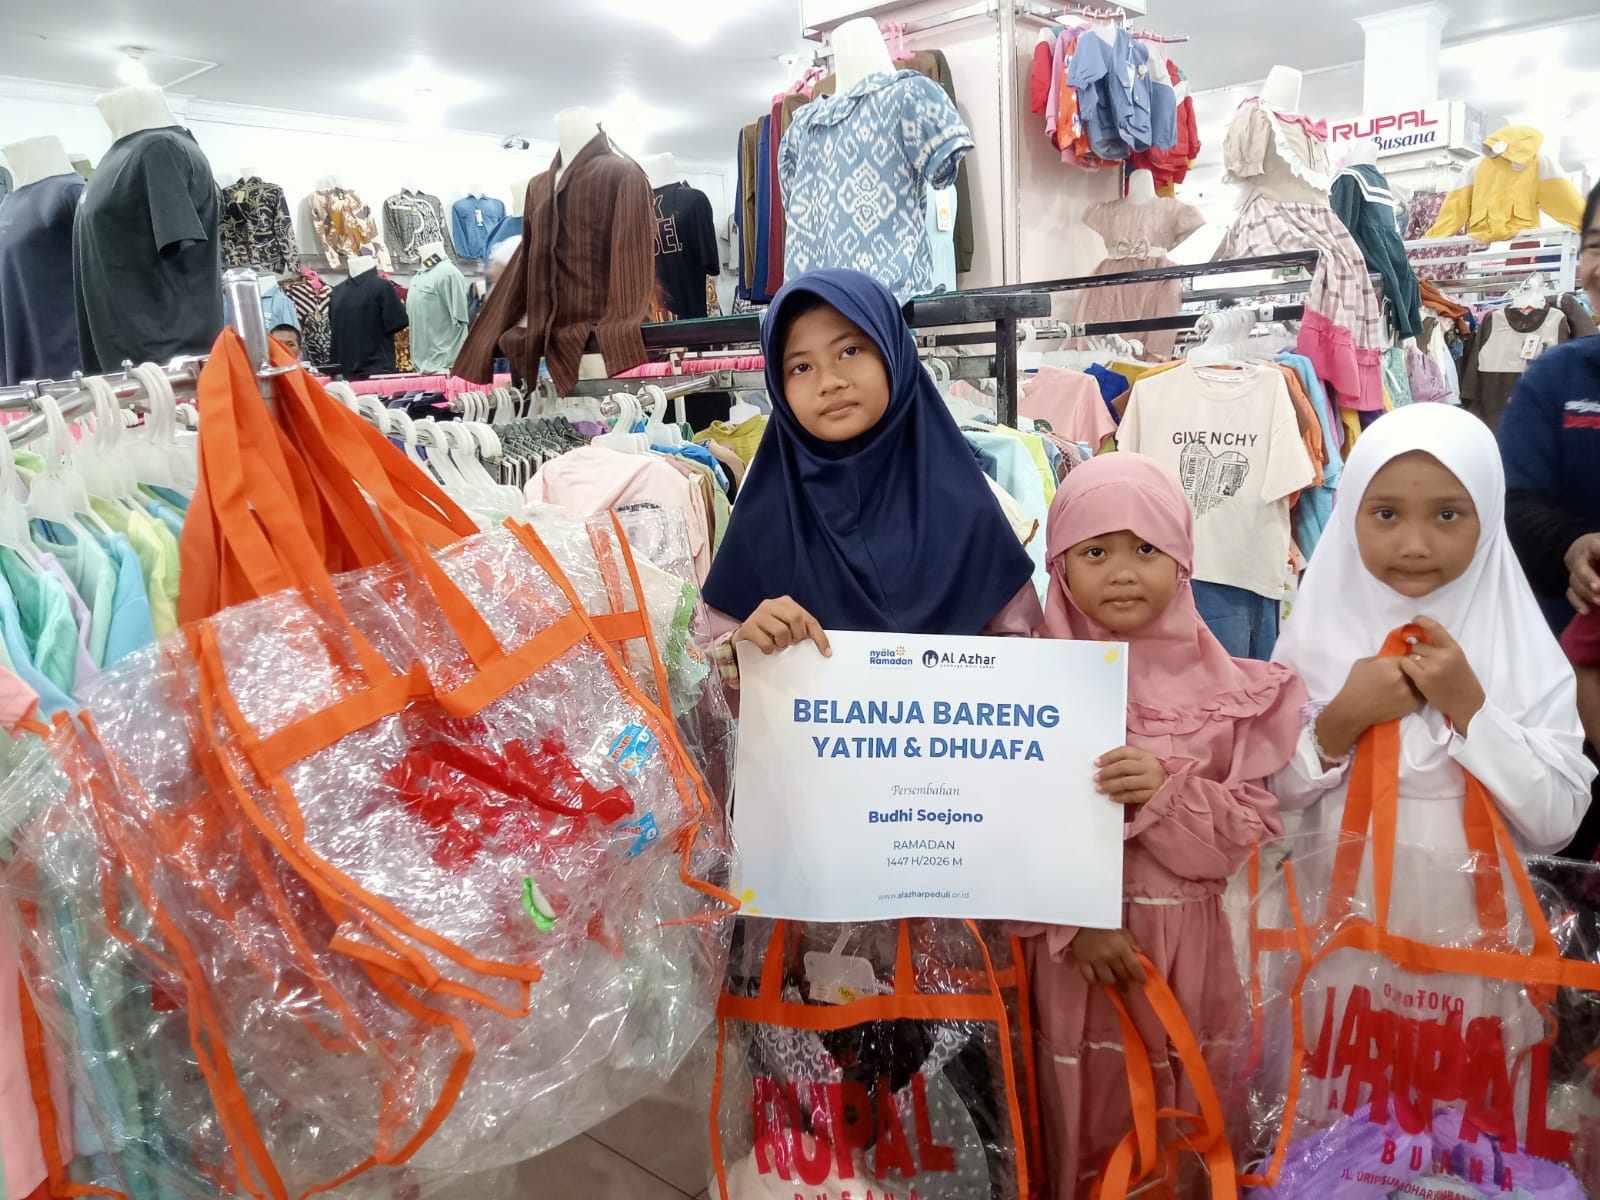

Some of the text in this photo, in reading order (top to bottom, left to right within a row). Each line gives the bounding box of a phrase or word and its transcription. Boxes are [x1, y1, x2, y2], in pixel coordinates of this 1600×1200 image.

[1332, 109, 1438, 142] RUPAL
[1372, 130, 1437, 151] Busana
[869, 656, 913, 665] Ramadan
[940, 652, 996, 665] Al Azhar
[793, 698, 1060, 728] BELANJA BARENG
[812, 736, 1044, 761] YATIM & DHUAFA
[891, 782, 961, 796] Persembahan
[868, 808, 984, 825] Budhi Soejono
[893, 840, 955, 850] RAMADAN
[887, 854, 963, 867] 1447 H/2026 M
[752, 1072, 956, 1186] RUPAL
